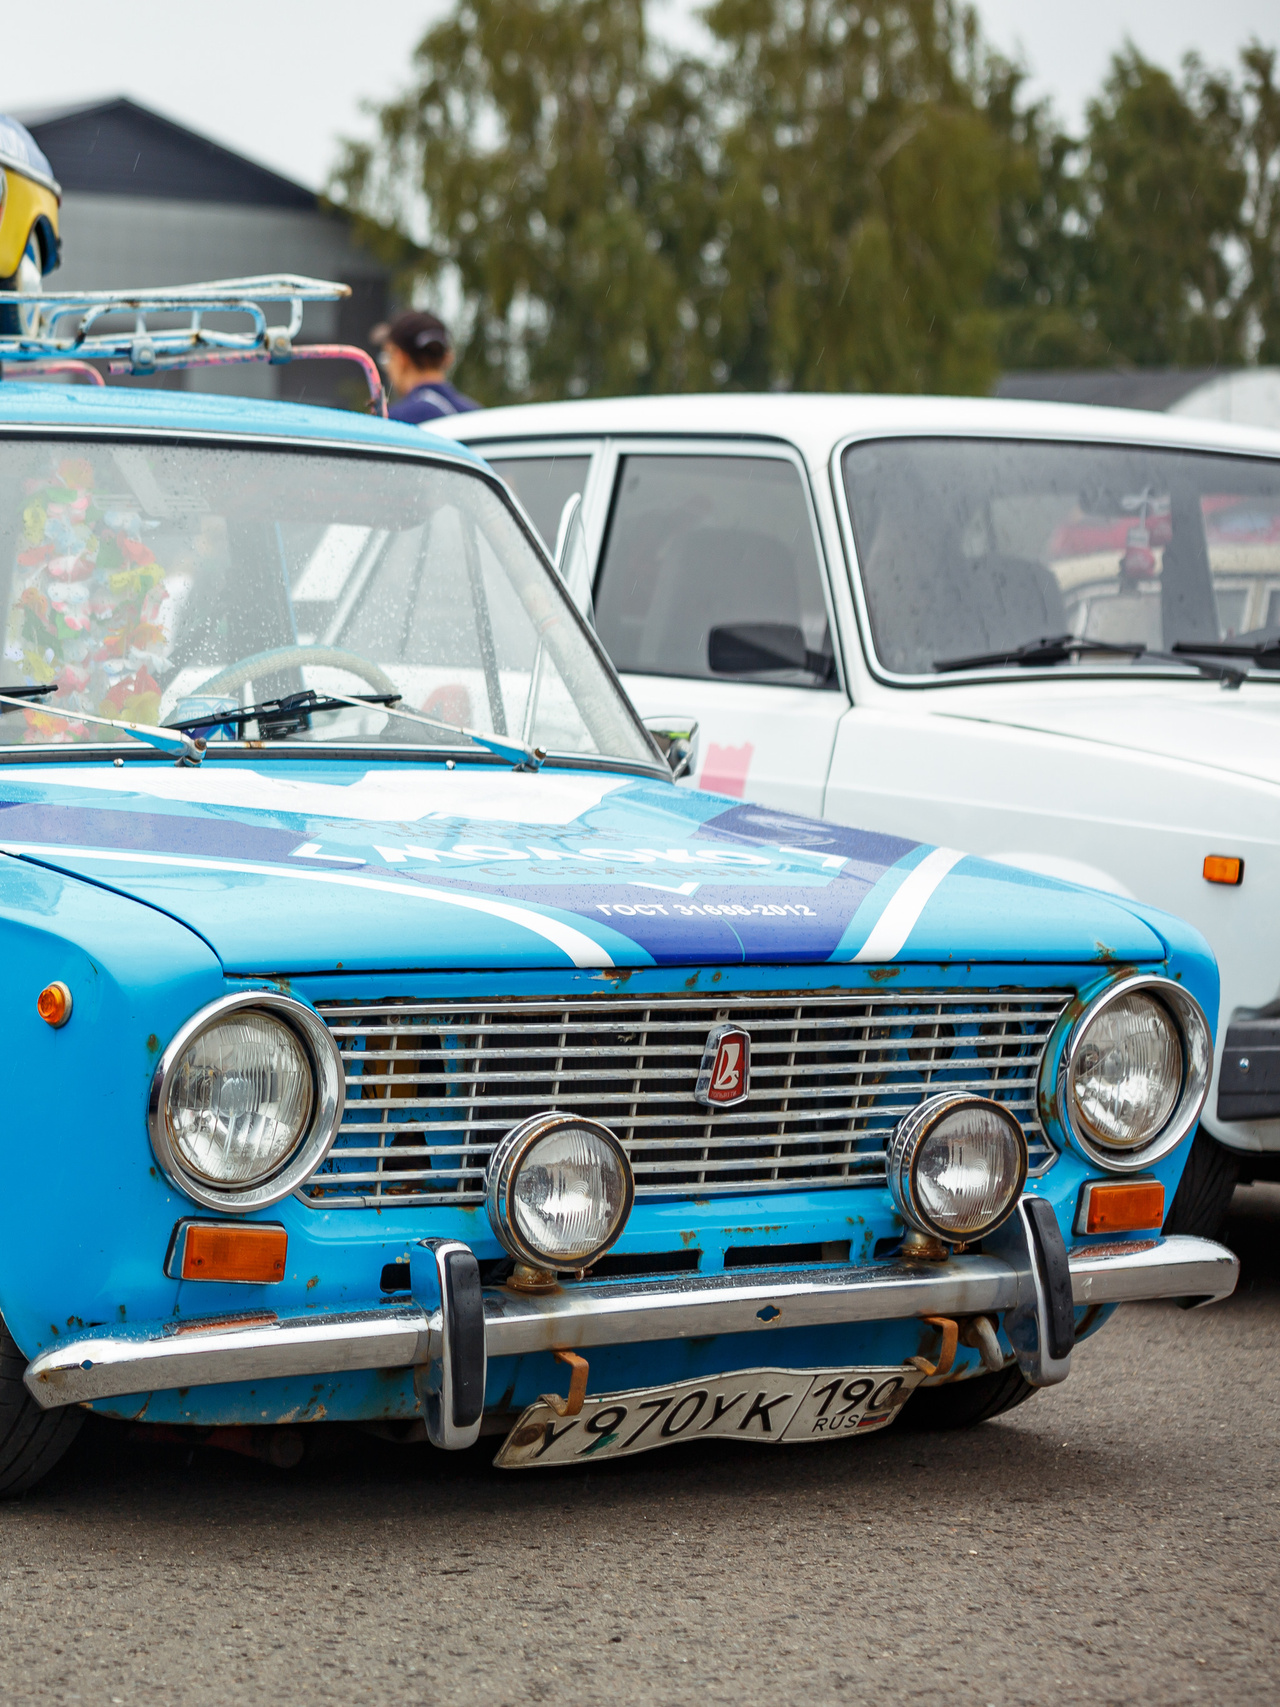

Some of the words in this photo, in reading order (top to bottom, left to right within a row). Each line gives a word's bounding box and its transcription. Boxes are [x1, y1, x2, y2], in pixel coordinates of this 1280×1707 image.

[372, 844, 771, 864] МОЛОКО
[595, 904, 672, 917] ГОСТ
[673, 903, 818, 917] 31688-2012
[813, 1376, 905, 1418] 190
[811, 1413, 860, 1433] RUS
